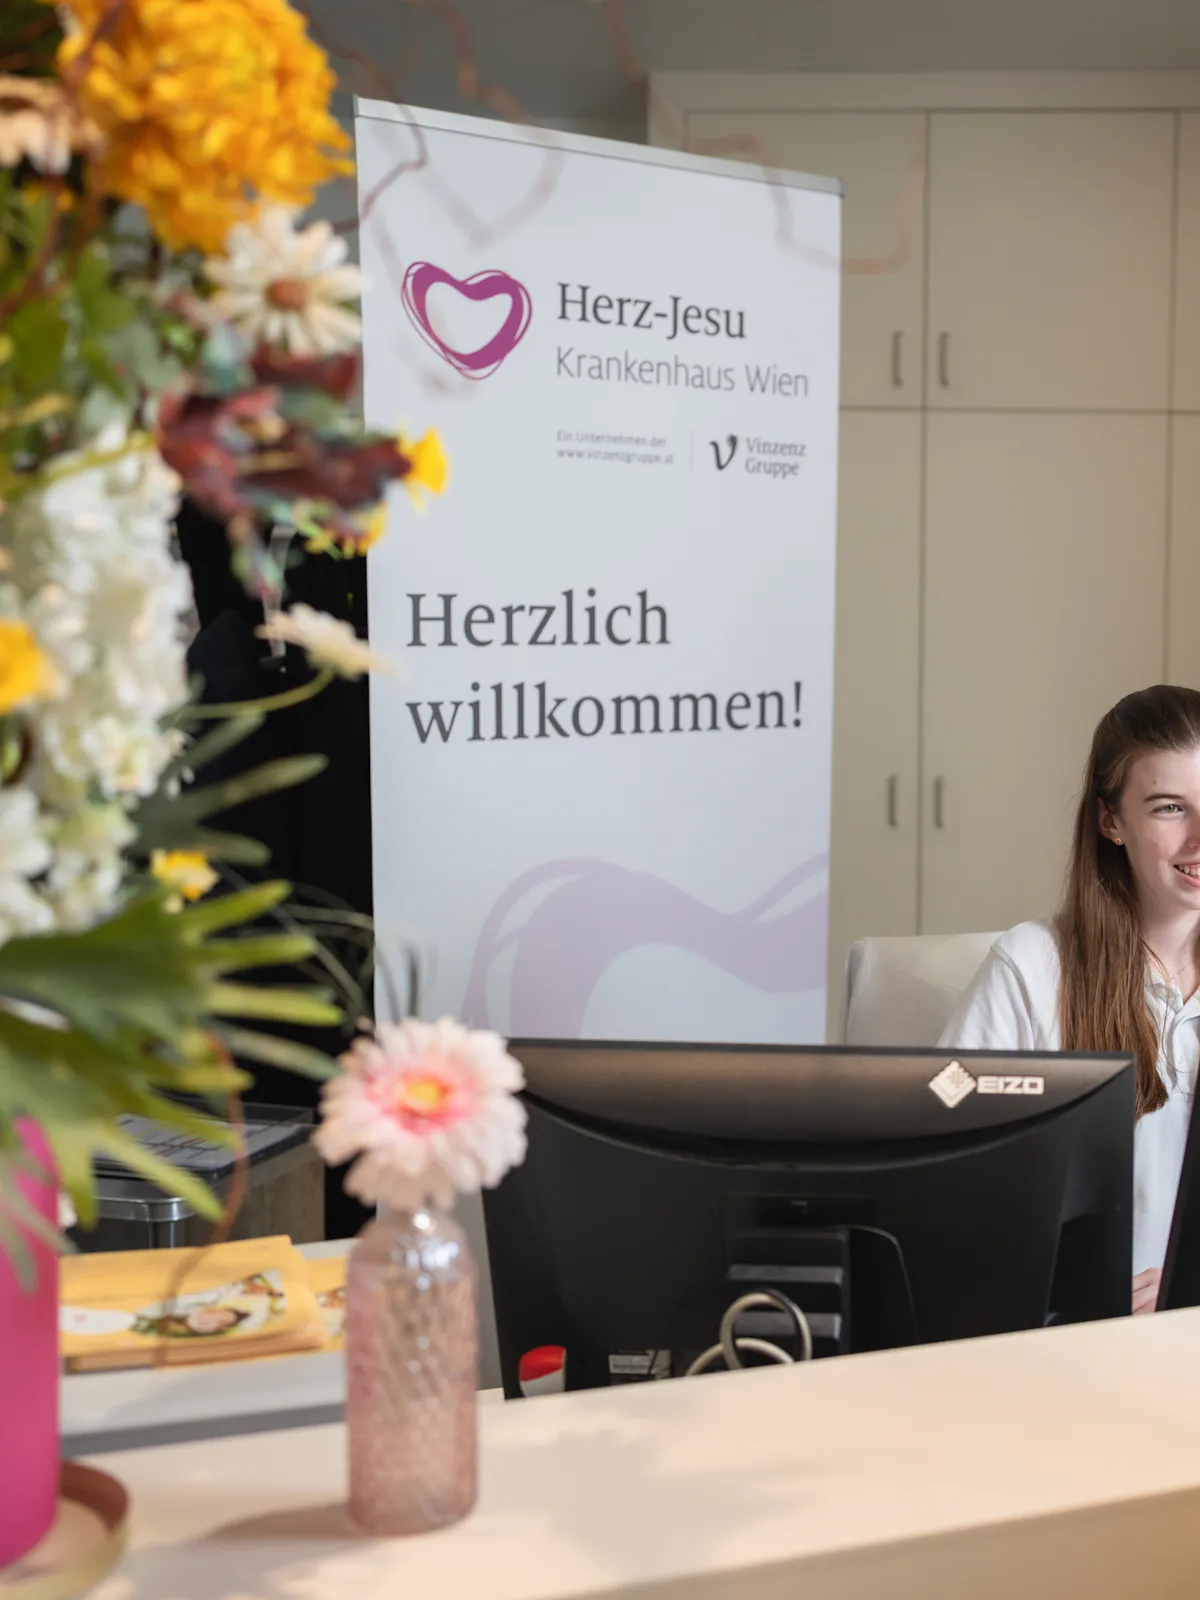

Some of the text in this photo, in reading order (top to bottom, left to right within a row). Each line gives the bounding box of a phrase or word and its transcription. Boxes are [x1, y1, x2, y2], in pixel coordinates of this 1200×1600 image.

[557, 282, 746, 340] Herz-Jesu
[556, 346, 809, 397] Krankenhaus Wien
[556, 430, 667, 448] Ein Unternehmen der
[745, 437, 807, 457] Vinzenz
[744, 458, 800, 479] Gruppe
[406, 587, 671, 647] Herzlich
[405, 680, 803, 744] willkommen!
[977, 1075, 1044, 1095] EIZO
